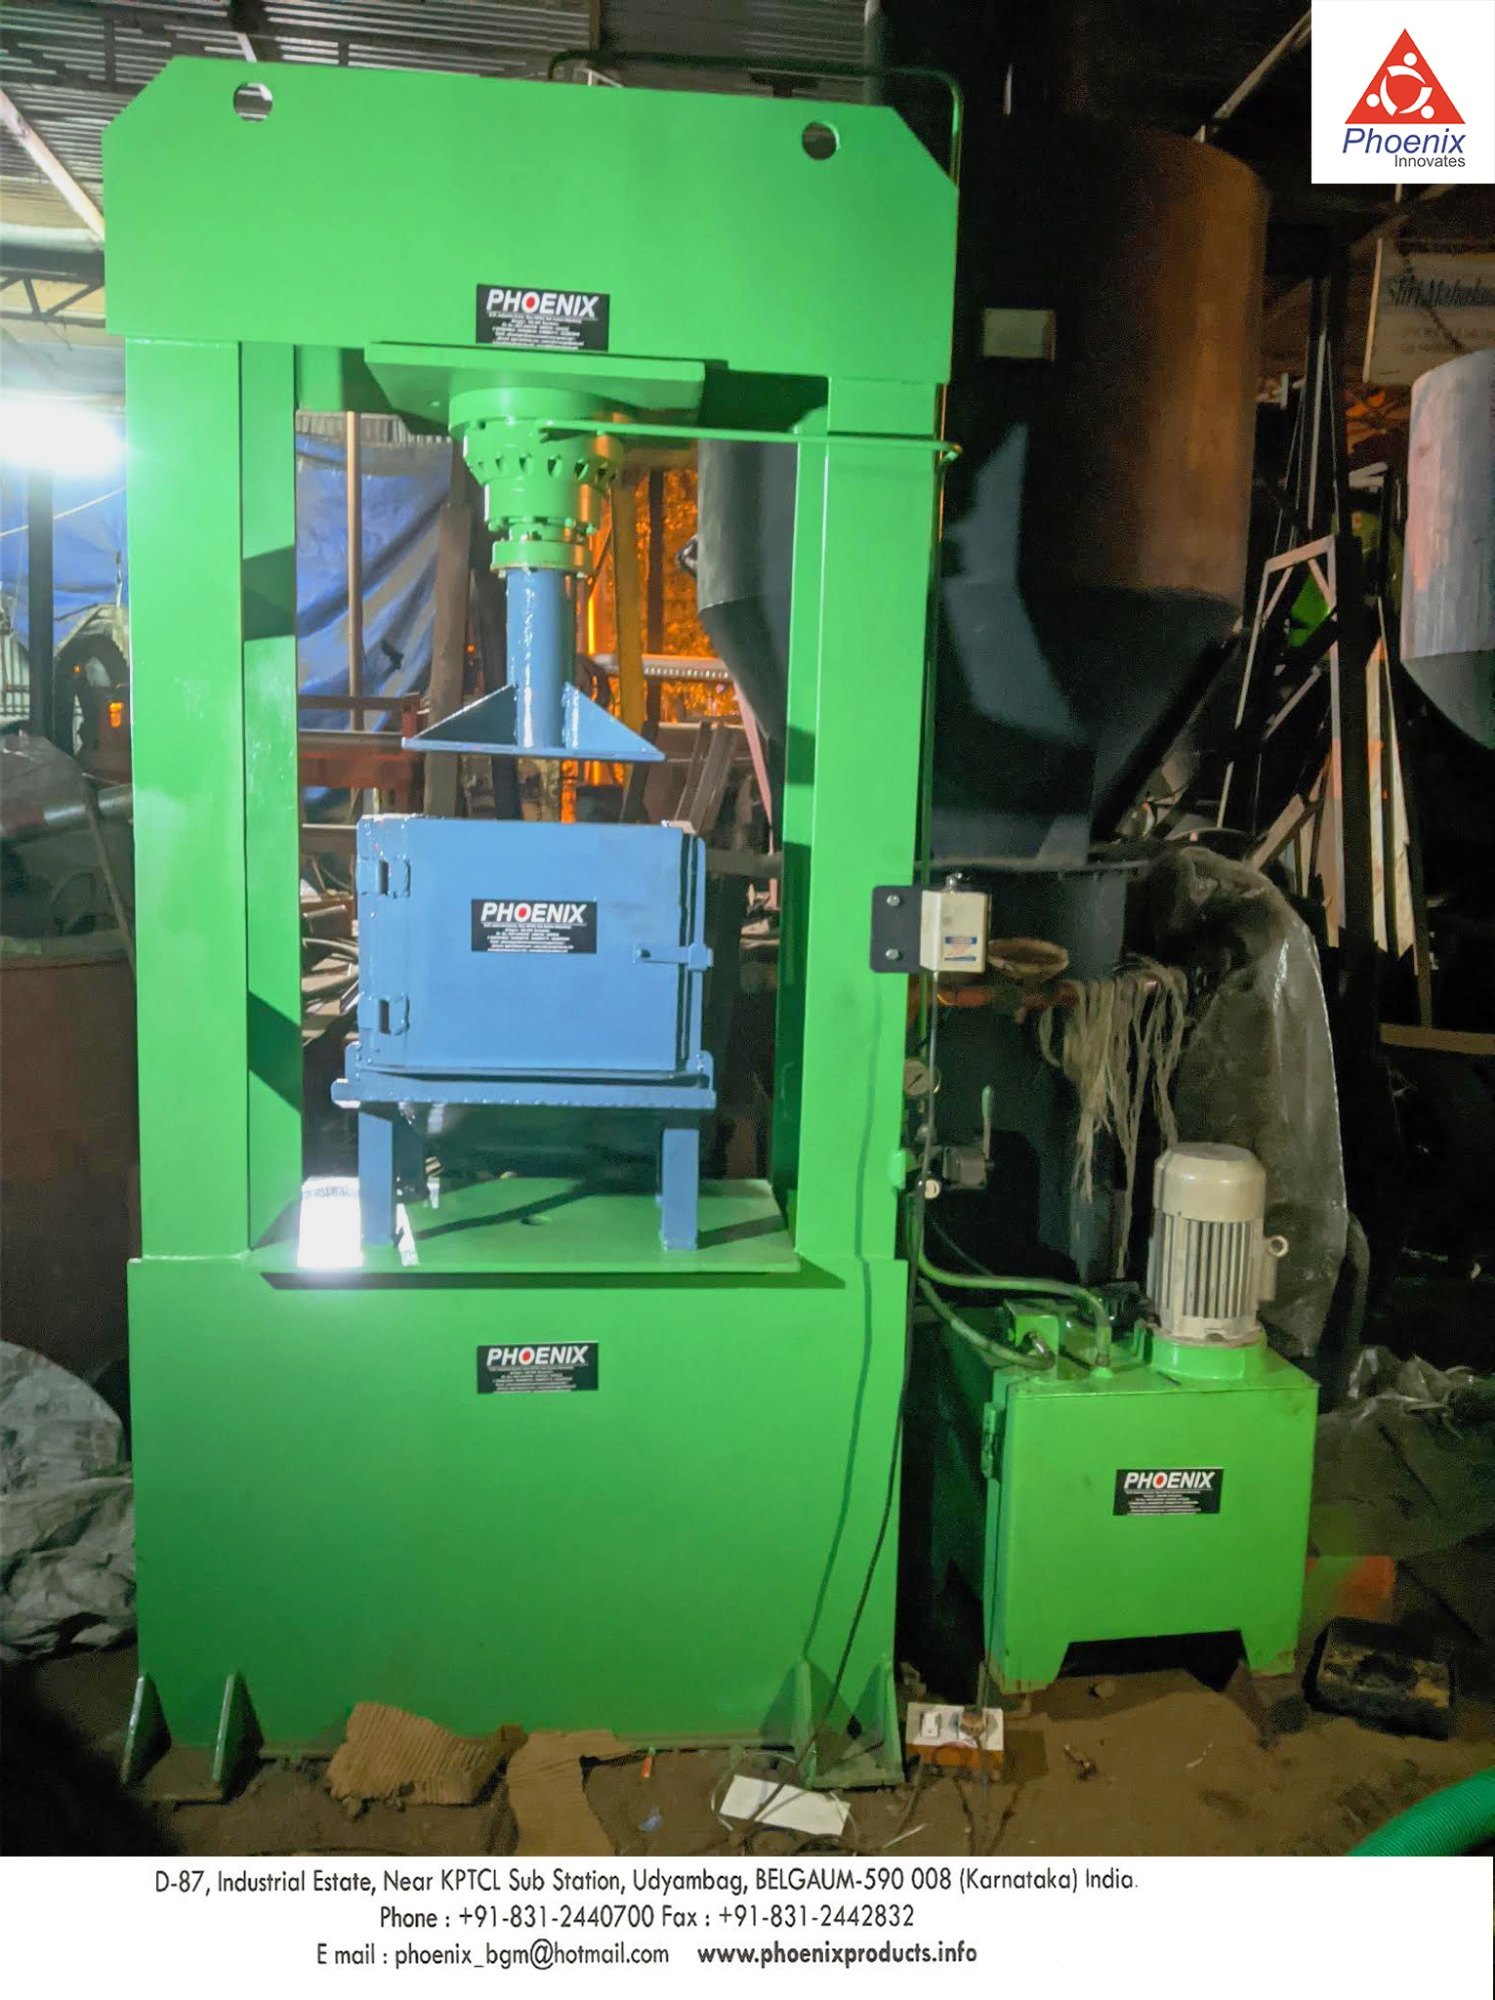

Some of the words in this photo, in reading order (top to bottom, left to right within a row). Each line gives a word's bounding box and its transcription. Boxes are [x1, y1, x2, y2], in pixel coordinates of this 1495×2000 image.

[486, 288, 599, 318] PHOENIX
[481, 902, 587, 923] PHOENIX
[486, 1345, 589, 1366] PHOENIX
[1124, 1471, 1215, 1489] PHOENIX
